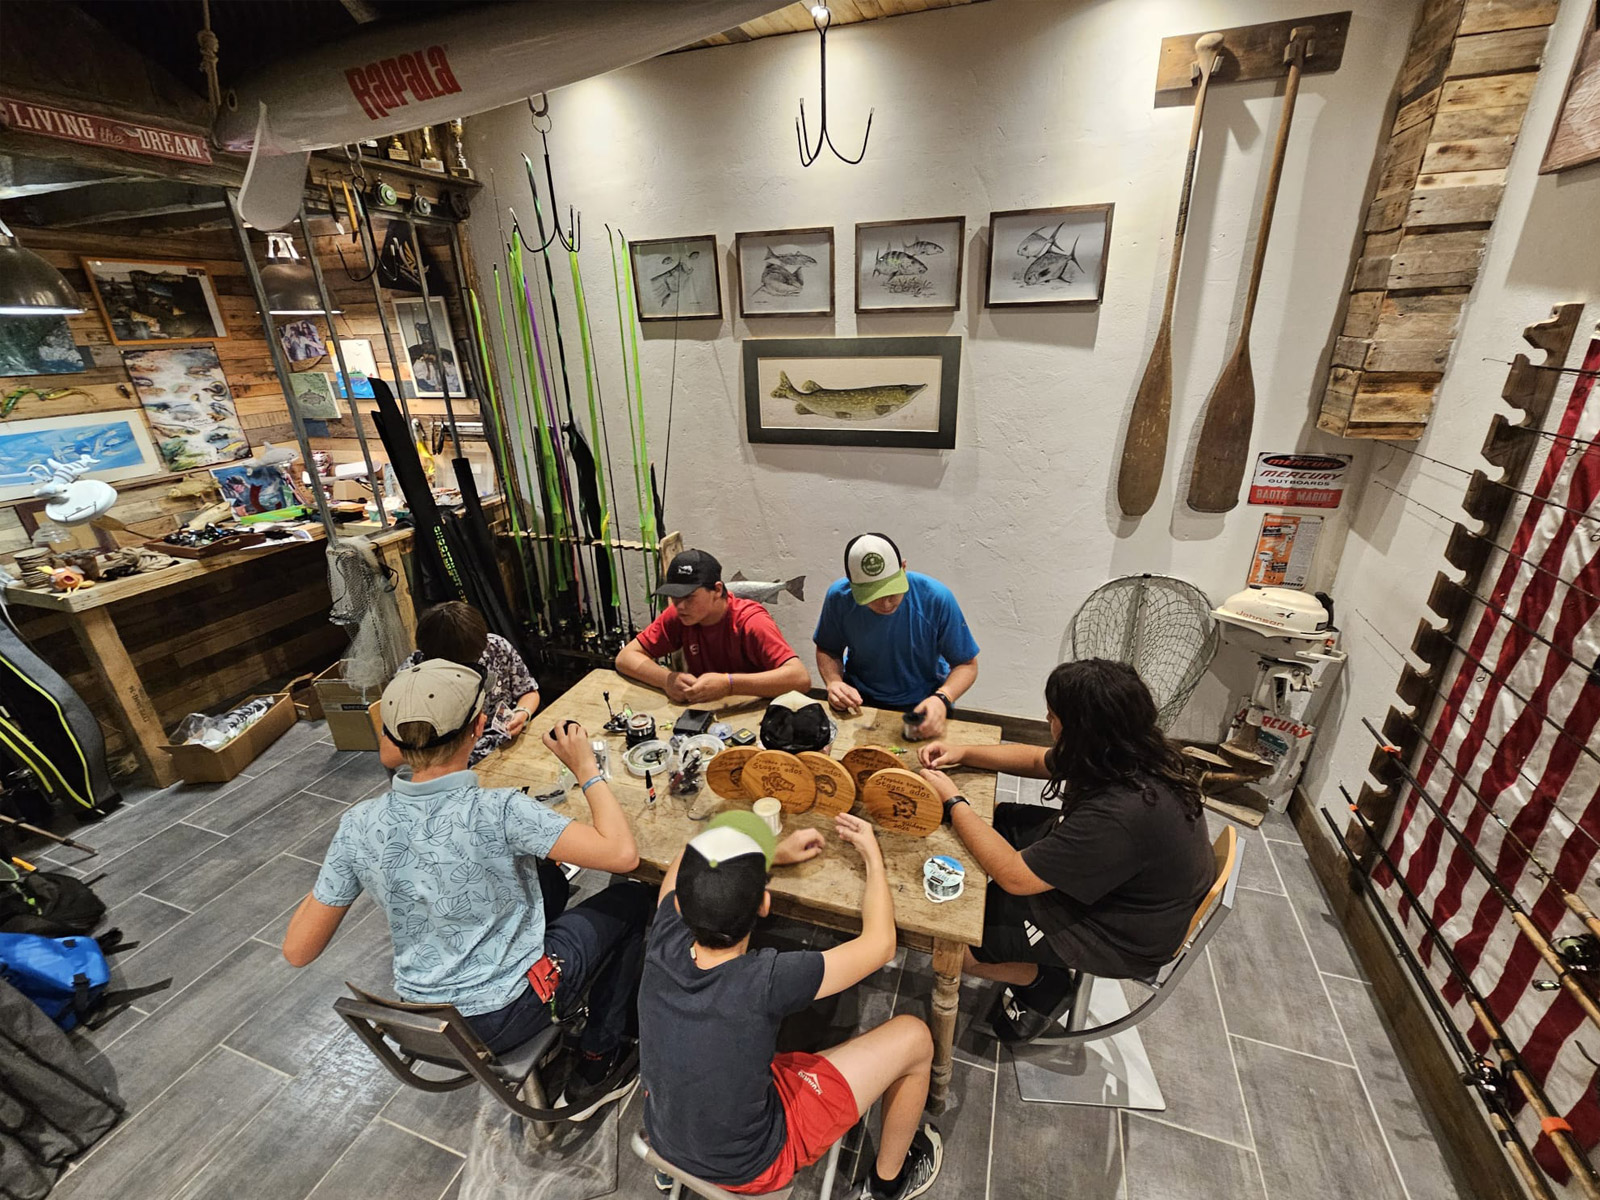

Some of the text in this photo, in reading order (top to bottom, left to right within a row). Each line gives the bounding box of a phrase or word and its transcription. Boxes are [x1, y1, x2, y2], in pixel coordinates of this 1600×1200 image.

[9, 103, 202, 158] LIVING the DREAM
[1266, 458, 1344, 468] MERCURY
[1260, 470, 1343, 480] MERCURY
[1236, 610, 1285, 628] Johnson
[1235, 708, 1313, 738] MRCURY
[753, 763, 781, 773] Stages
[875, 779, 931, 799] Stages ados
